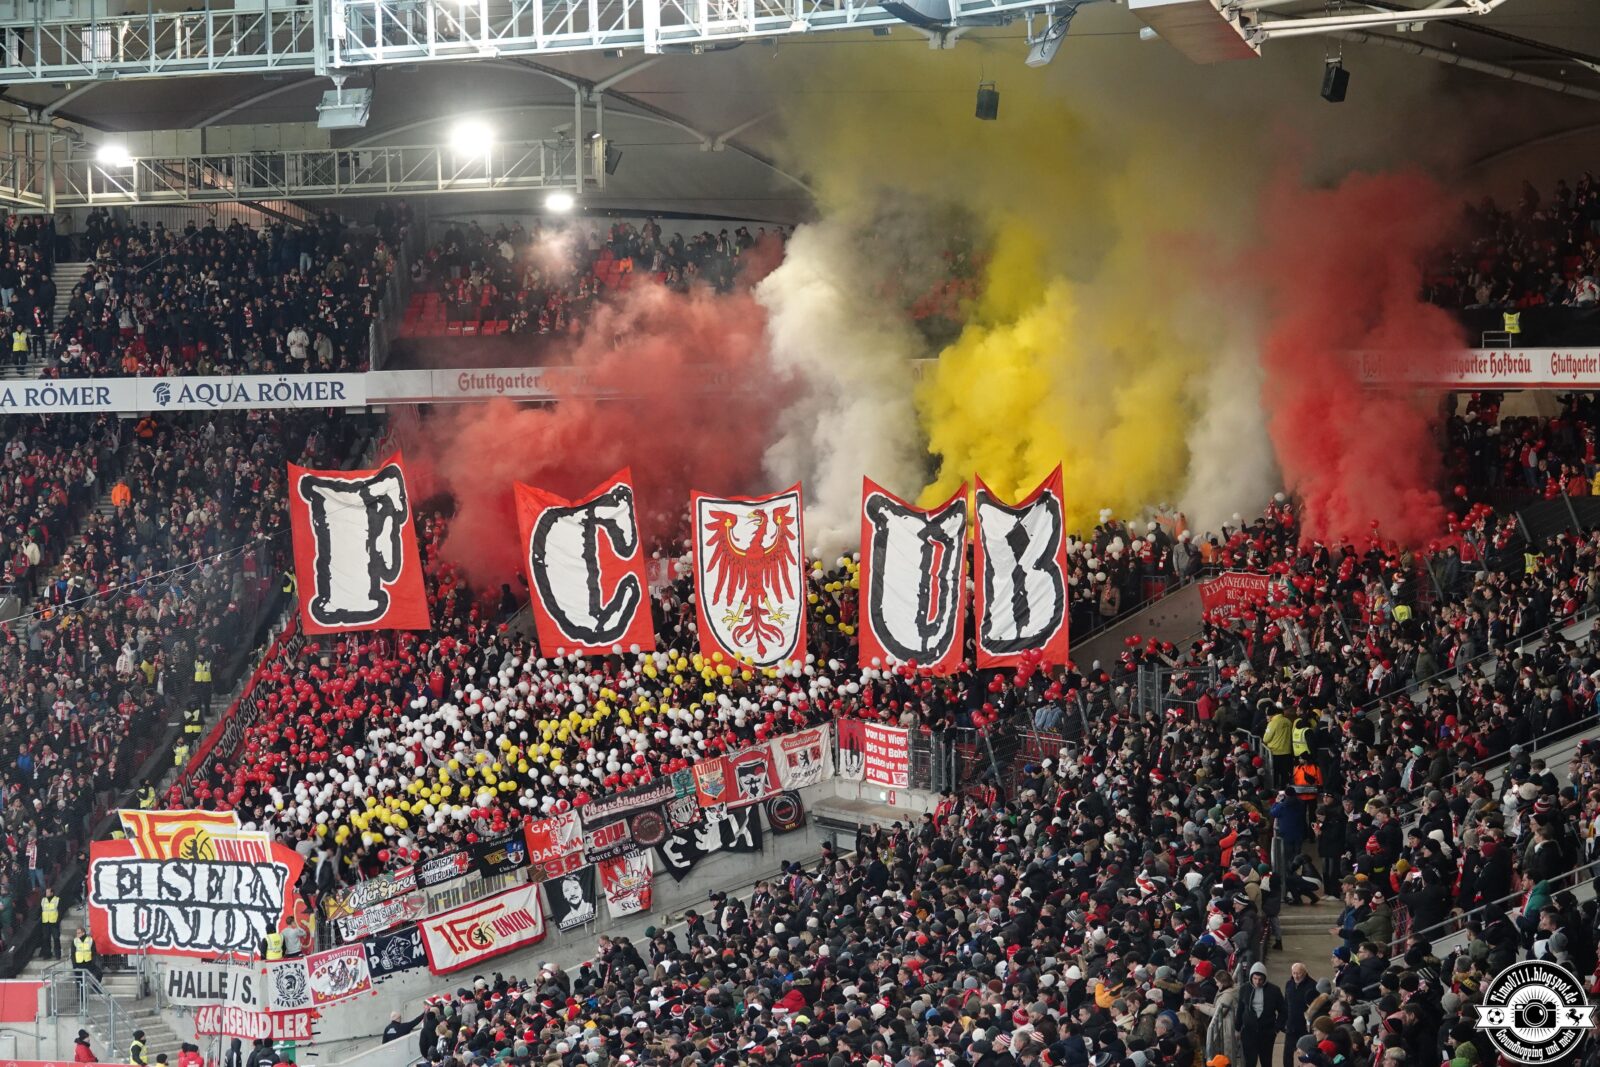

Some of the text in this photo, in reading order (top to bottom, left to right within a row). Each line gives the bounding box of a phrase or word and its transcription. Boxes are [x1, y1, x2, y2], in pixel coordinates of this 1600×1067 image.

[1551, 352, 1598, 380] Stuttgarter
[24, 382, 112, 407] RÖMER
[177, 377, 347, 407] AQUA RÖMER
[458, 371, 540, 394] Stuttgarter
[581, 783, 673, 818] Oberschöneweide
[214, 837, 267, 863] UNION
[533, 836, 584, 862] BARNIM
[545, 852, 583, 879] 98
[95, 859, 287, 910] EISERN
[349, 888, 379, 908] Oder
[379, 875, 417, 899] Spree
[109, 902, 278, 954] UNION
[493, 908, 537, 938] UNION
[272, 962, 307, 974] SIXTY
[168, 969, 228, 1000] HALLE
[274, 994, 310, 1008] NINERS
[198, 1005, 309, 1038] SACHSENADLER
